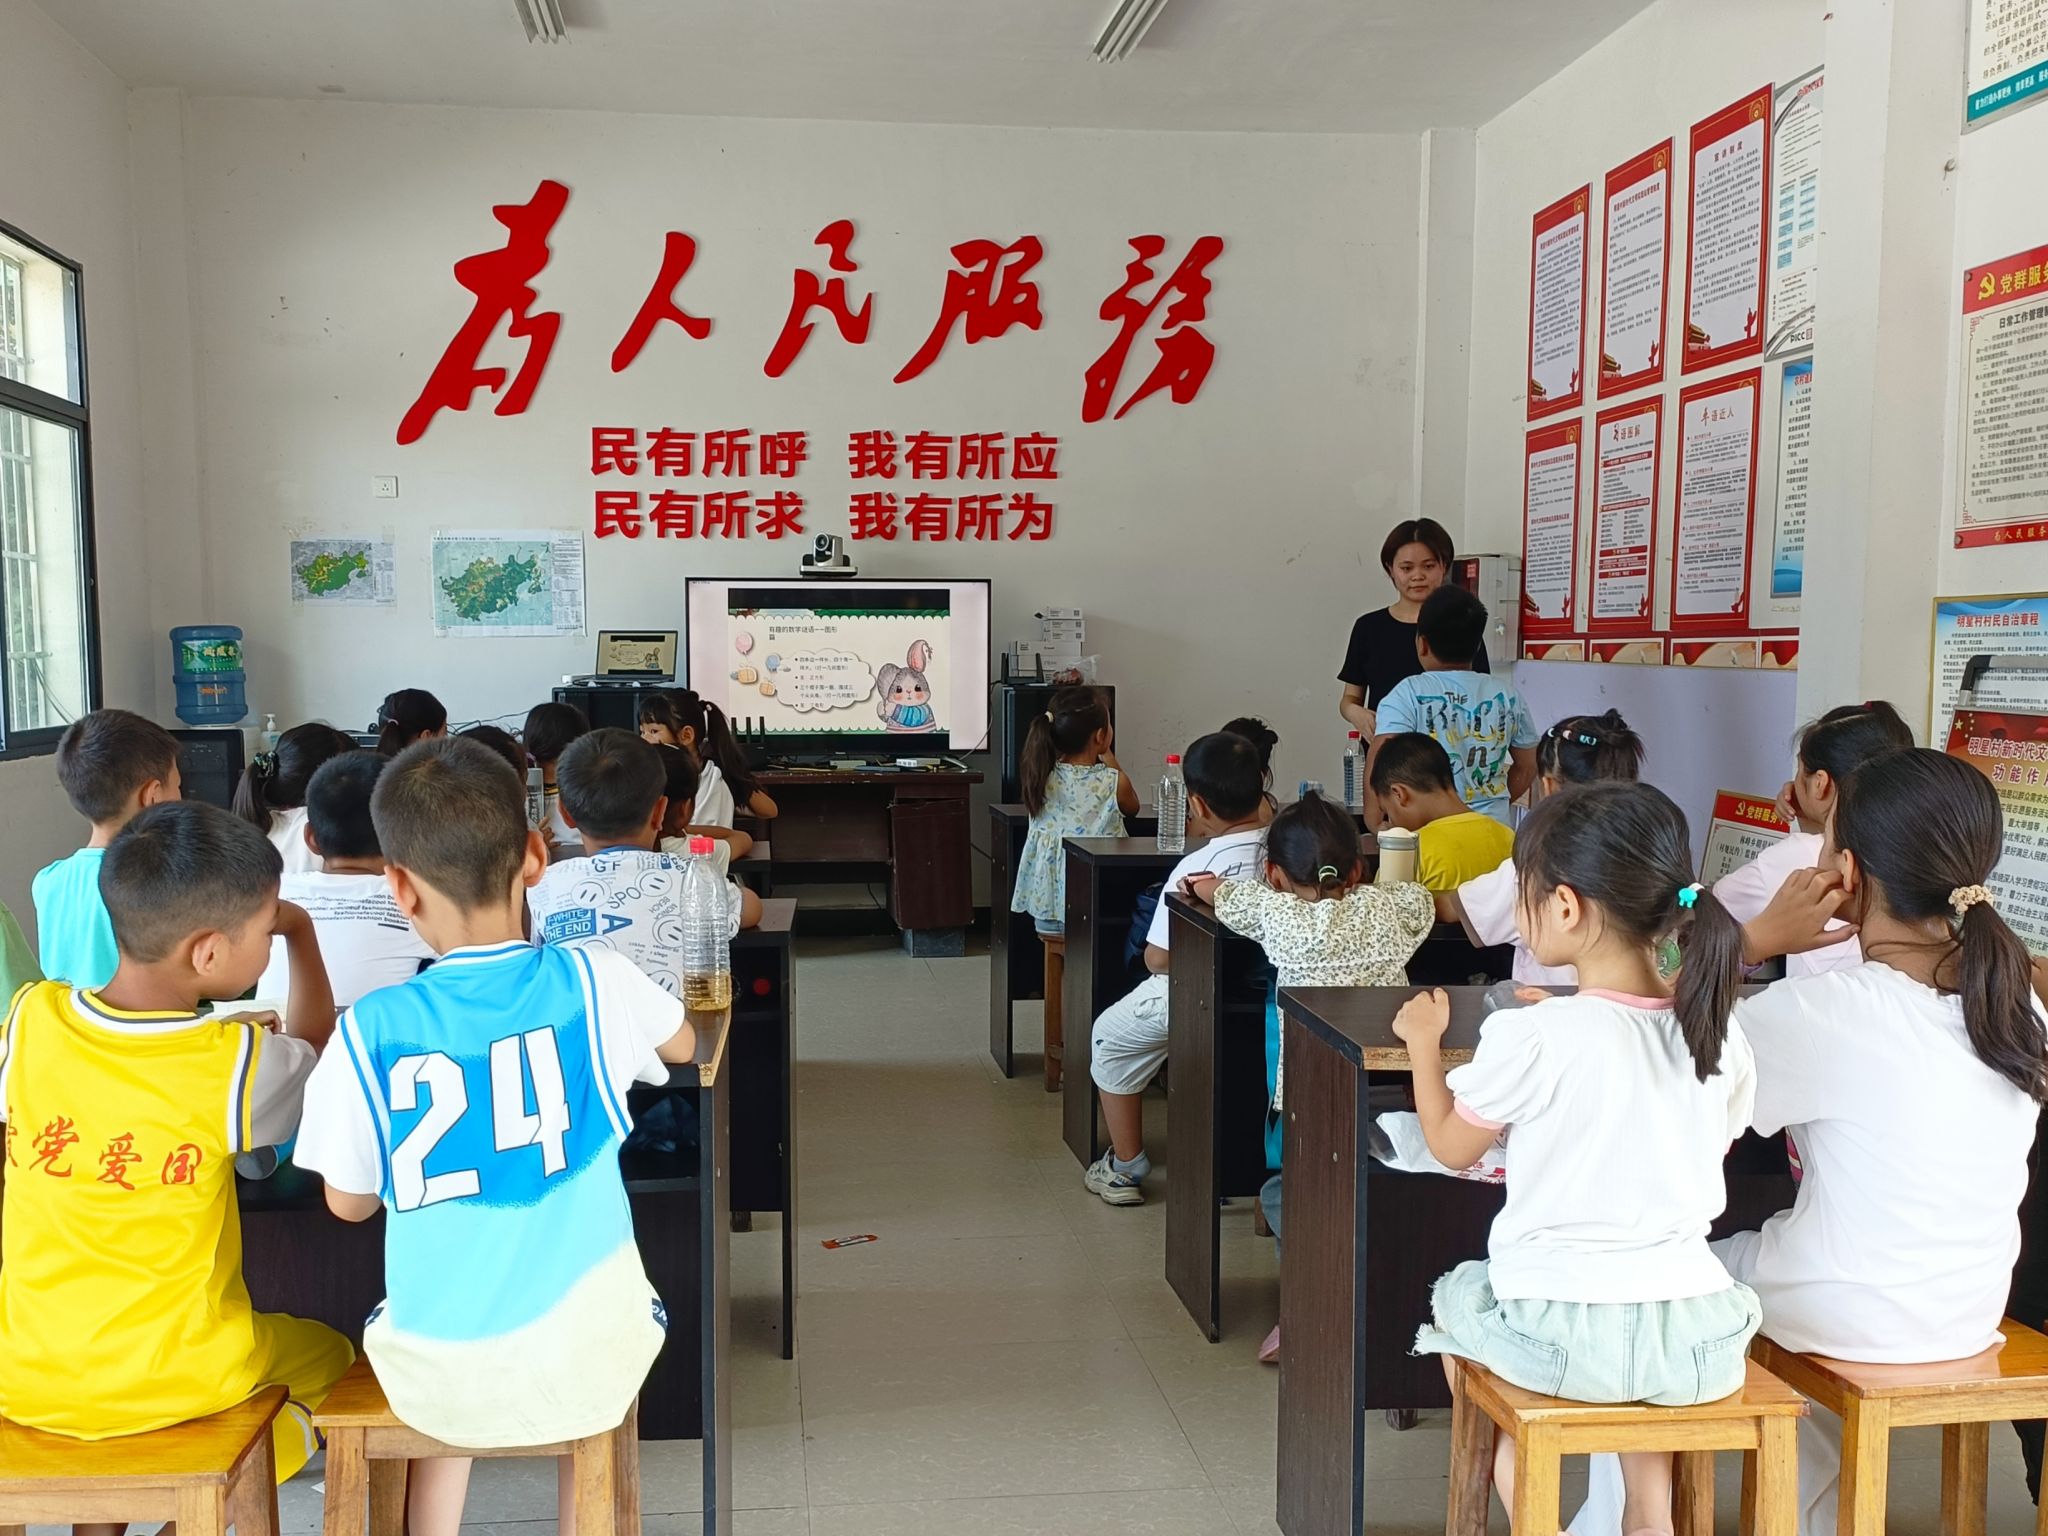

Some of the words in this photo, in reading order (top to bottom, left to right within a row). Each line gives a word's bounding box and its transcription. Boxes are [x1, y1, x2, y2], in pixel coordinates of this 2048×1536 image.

[397, 179, 1224, 445] 为人民服务
[592, 427, 806, 477] 民有所呼
[849, 430, 1057, 479] 我有所应
[595, 489, 803, 539] 民有所求
[850, 491, 1052, 541] 我有所为
[1956, 612, 2039, 628] 明星村村民自治章程
[1445, 691, 1468, 704] THE
[1992, 763, 2048, 787] 功能作
[564, 921, 591, 937] END
[389, 1025, 572, 1213] 24
